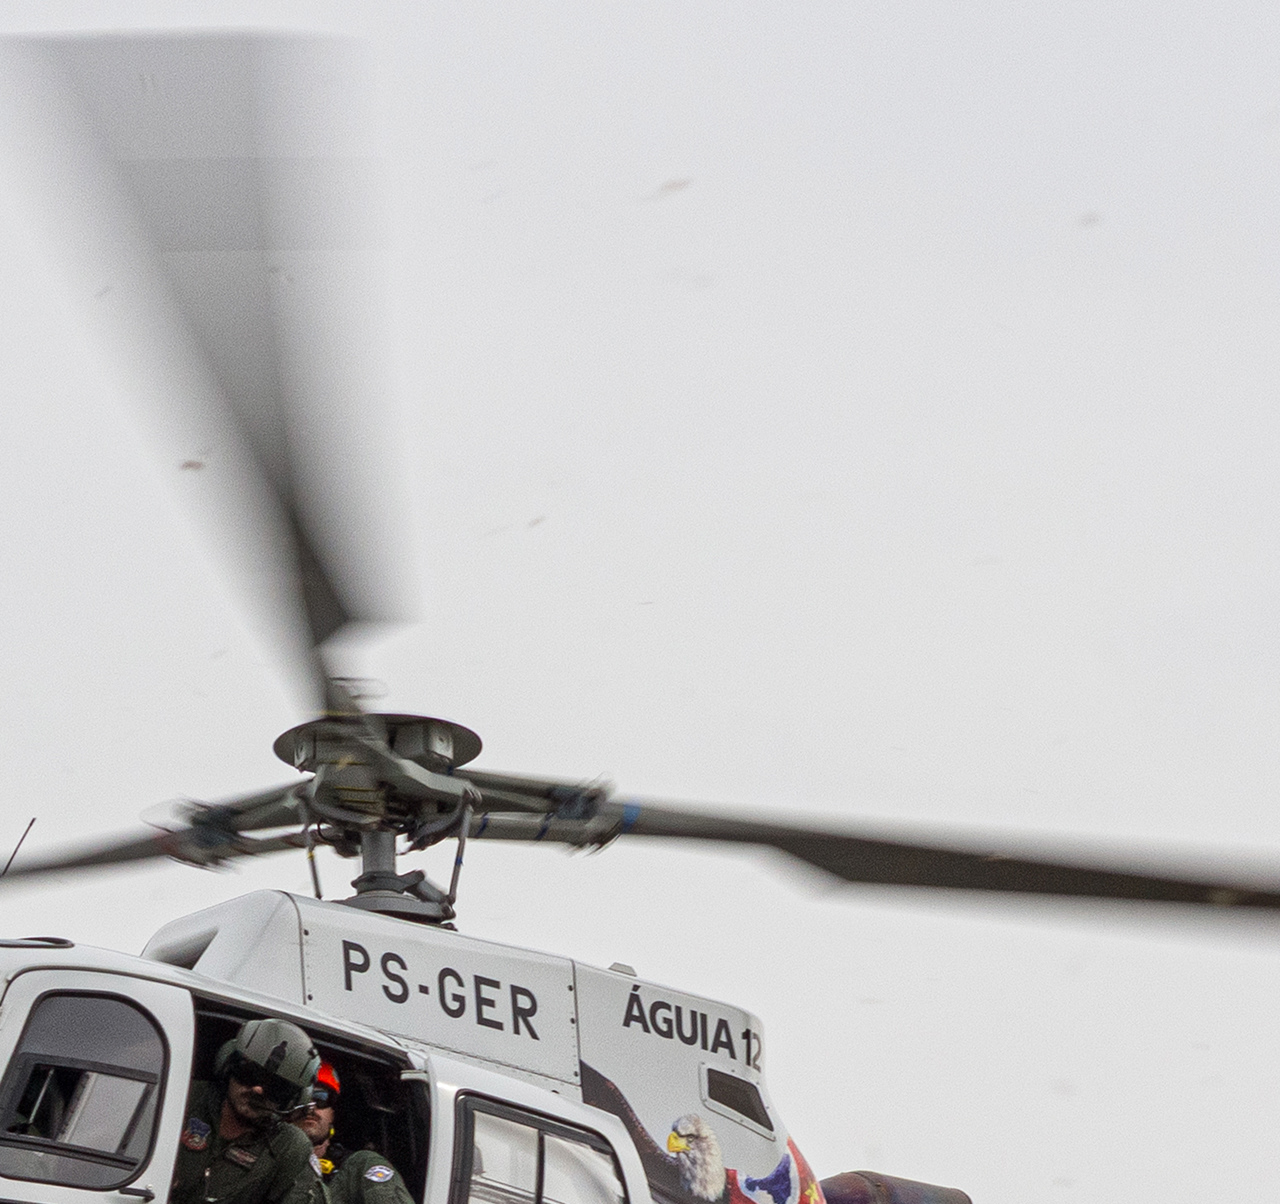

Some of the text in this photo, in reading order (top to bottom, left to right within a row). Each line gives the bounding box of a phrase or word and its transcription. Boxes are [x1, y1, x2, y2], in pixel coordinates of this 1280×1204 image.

[342, 939, 540, 1041] PS-GER
[622, 984, 762, 1074] ÁGUIA 12
